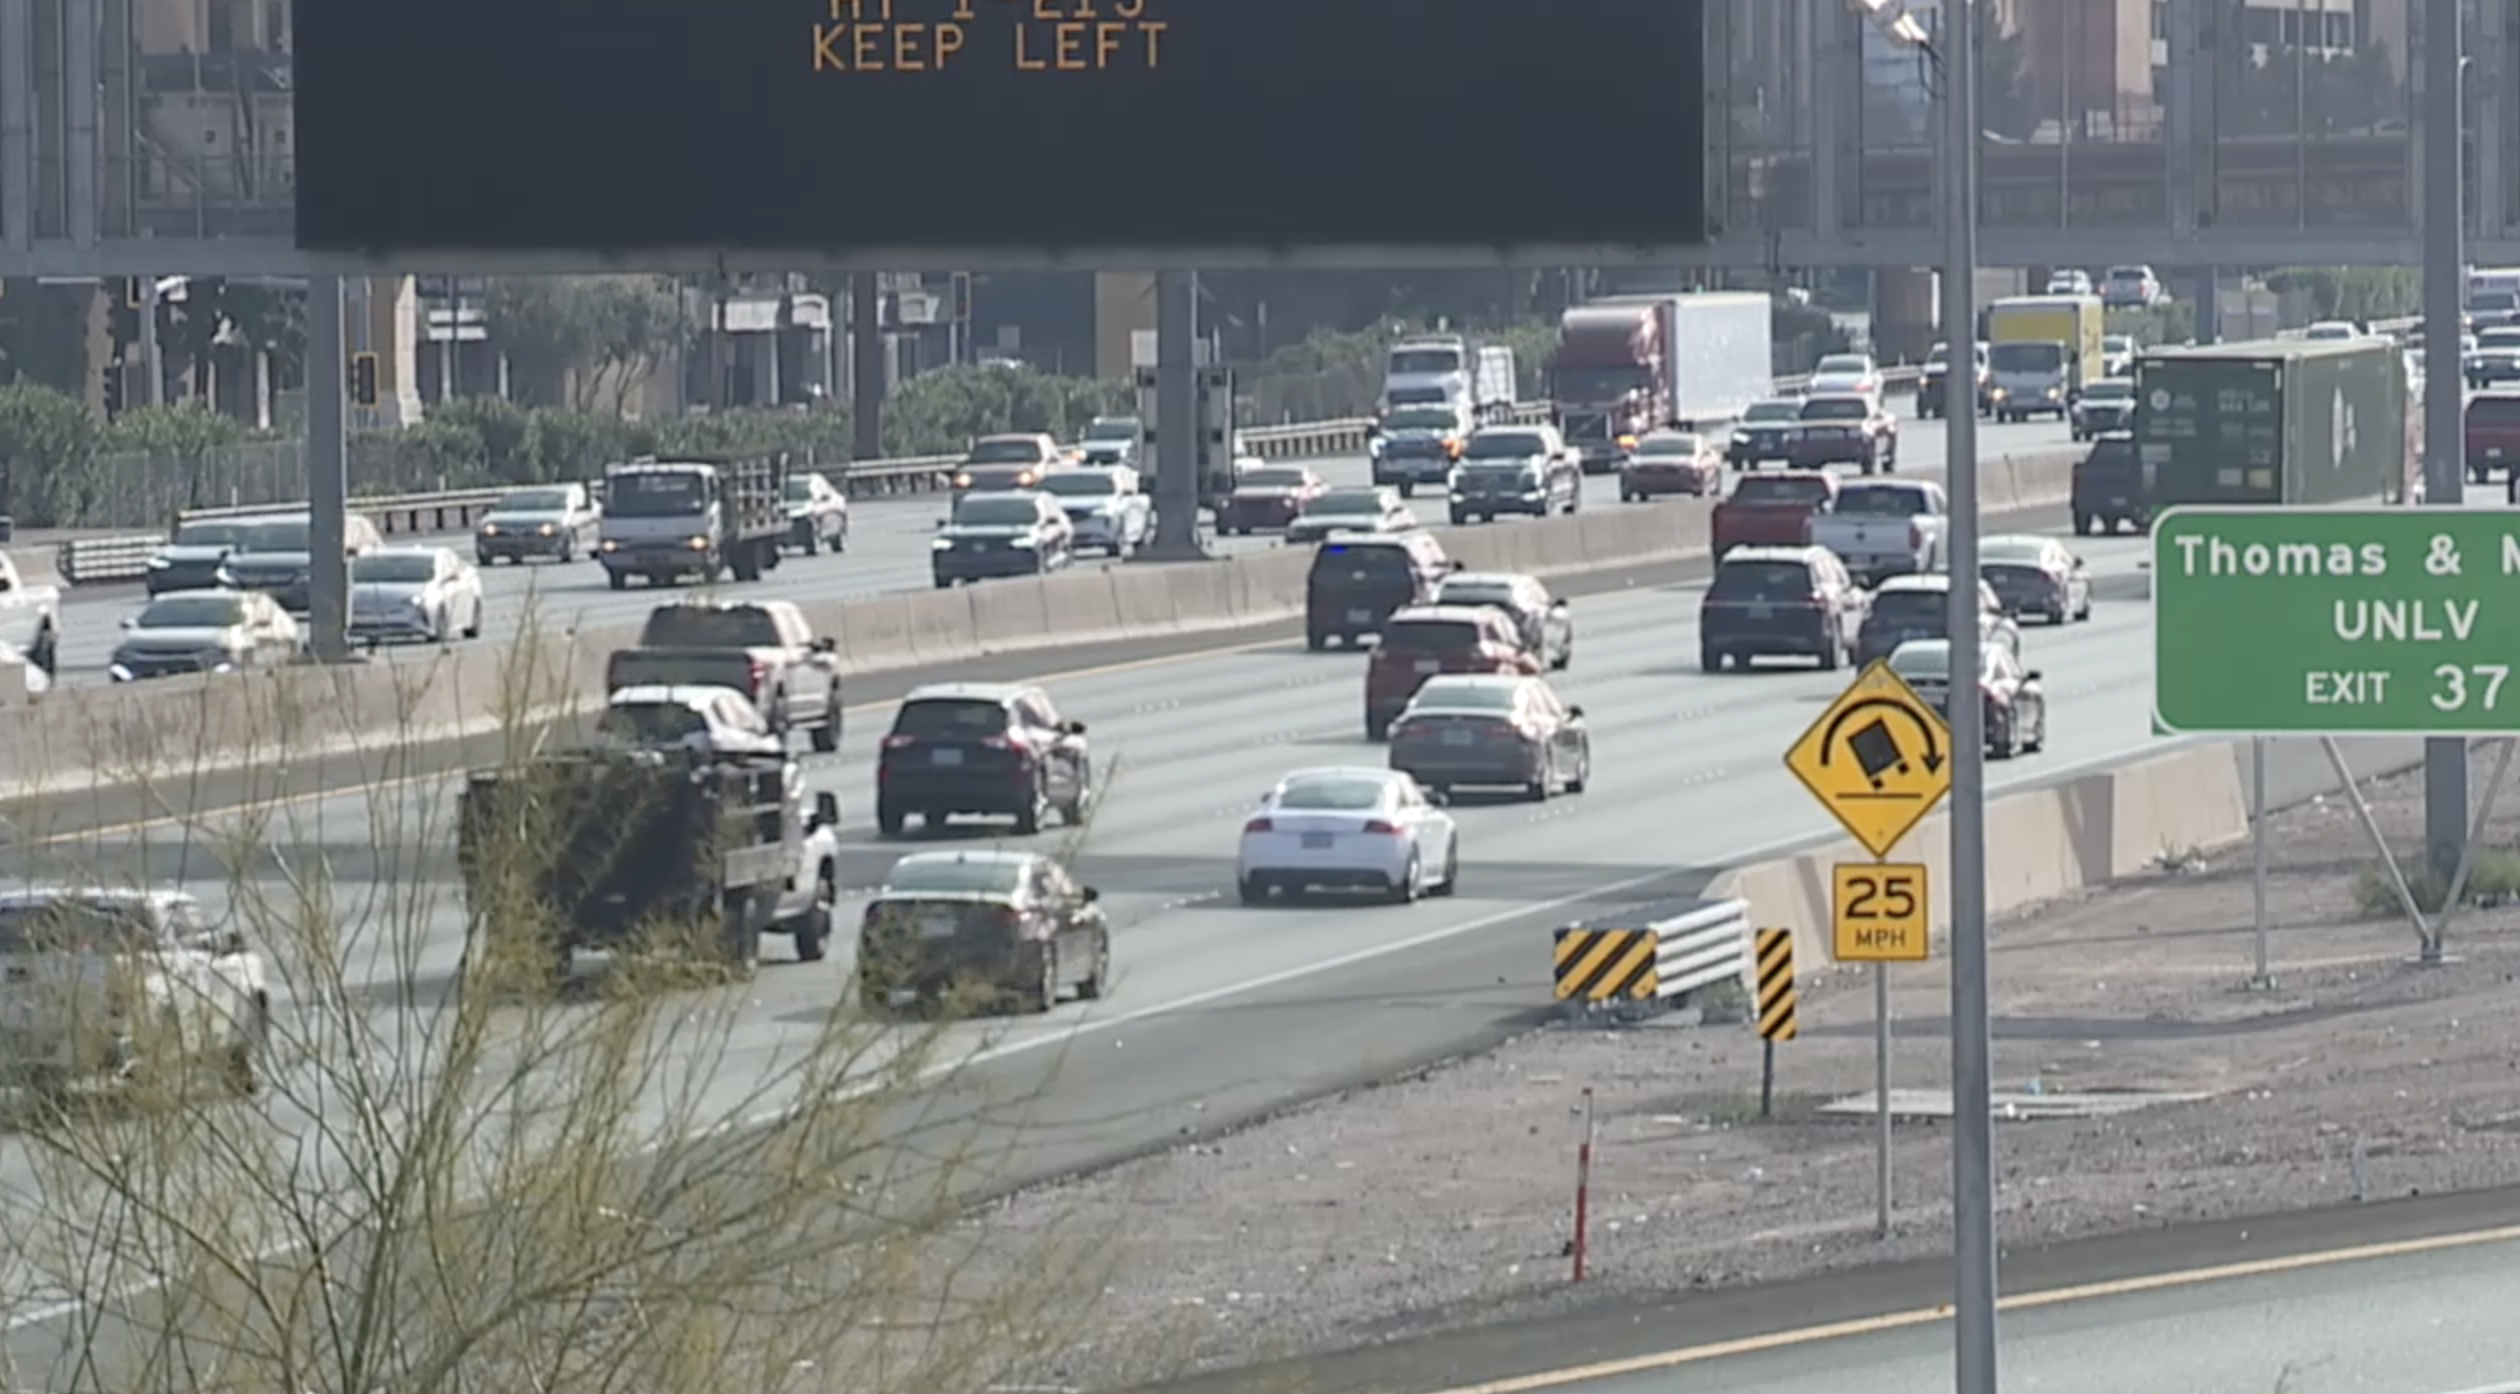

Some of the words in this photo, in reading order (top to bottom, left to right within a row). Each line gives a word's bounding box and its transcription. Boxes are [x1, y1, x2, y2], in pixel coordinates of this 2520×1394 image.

[813, 23, 964, 70] KEEP
[1016, 23, 1167, 68] LEFT
[2175, 534, 2388, 576] Thomas
[2425, 534, 2461, 576] &
[2334, 600, 2479, 641] UNLV
[2306, 671, 2390, 704] EXIT
[2431, 663, 2509, 710] 37
[1846, 877, 1915, 919] 25
[1855, 929, 1906, 948] MPH
